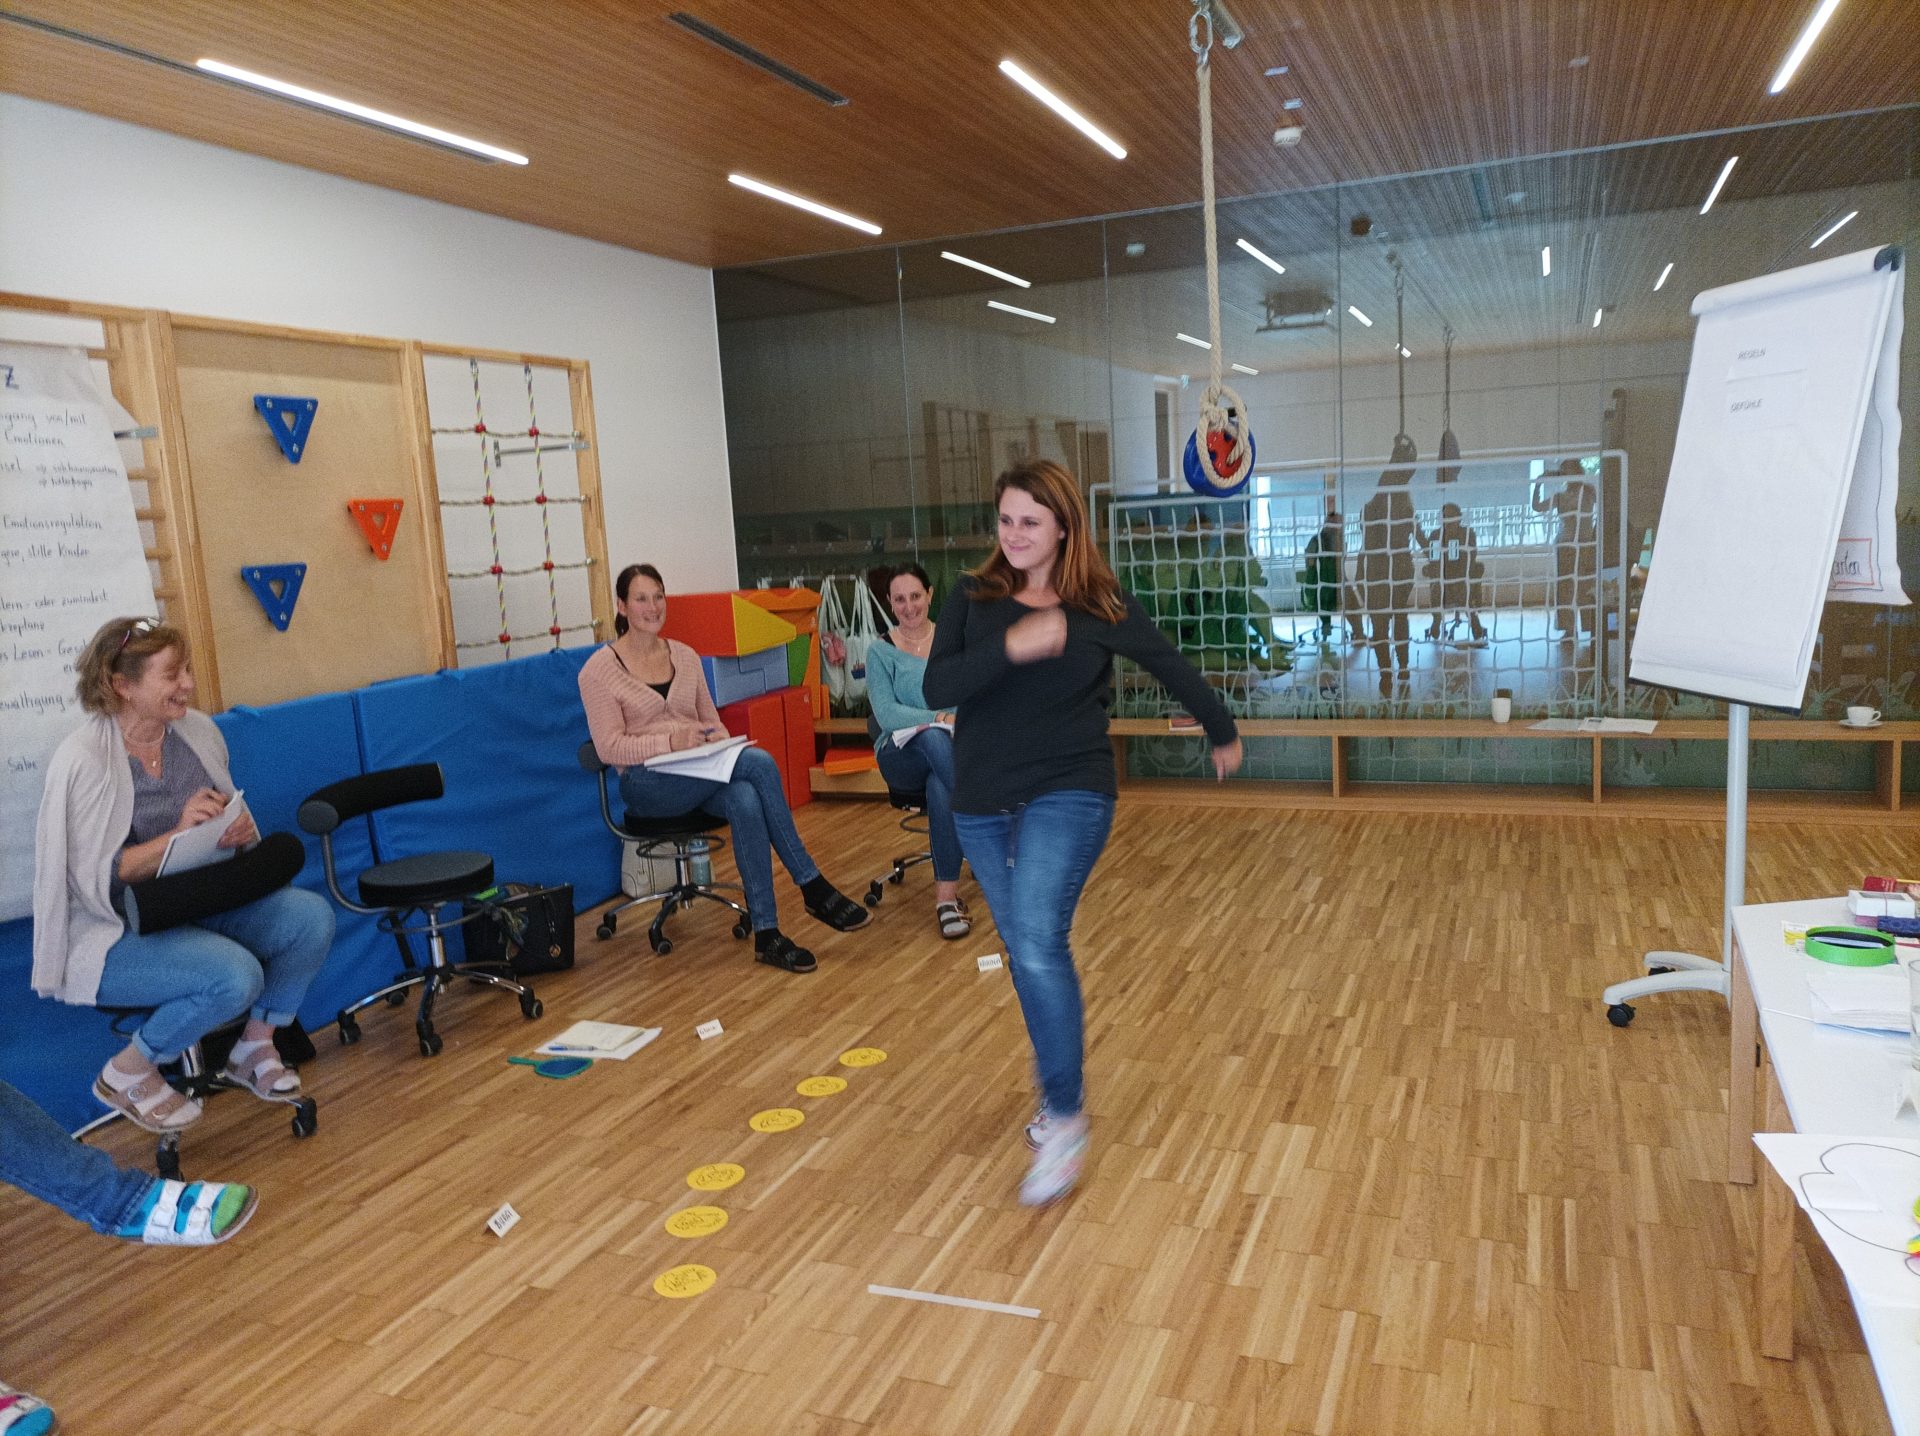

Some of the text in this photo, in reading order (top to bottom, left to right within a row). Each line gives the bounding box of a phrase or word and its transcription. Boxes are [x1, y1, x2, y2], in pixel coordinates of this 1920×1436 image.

[4, 430, 64, 447] Emotionen
[3, 511, 102, 535] Emotionsregulation
[58, 541, 89, 558] Kinder
[1832, 550, 1861, 577] arten
[62, 588, 109, 607] zumindest
